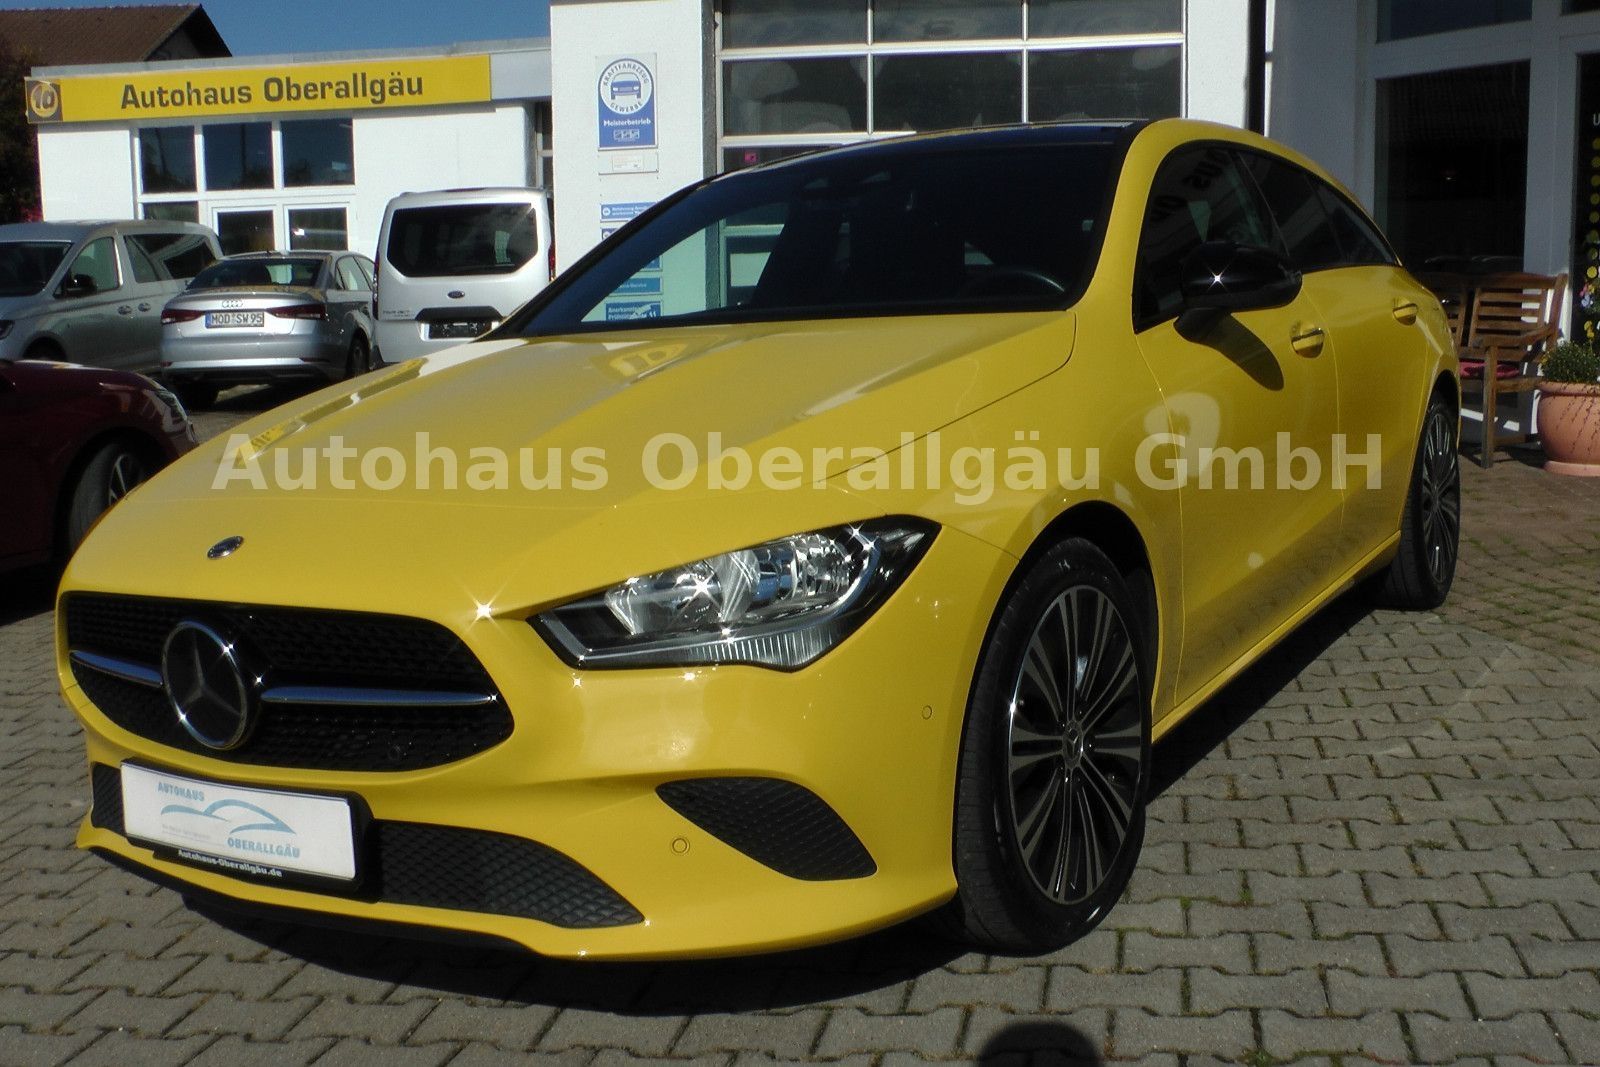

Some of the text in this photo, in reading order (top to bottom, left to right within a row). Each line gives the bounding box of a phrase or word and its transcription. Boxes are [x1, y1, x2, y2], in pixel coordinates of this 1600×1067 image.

[603, 62, 650, 86] KRAFTFAHRZEUG
[121, 72, 423, 110] Autohaus Oberallgäu
[610, 102, 643, 113] GEWERBE
[603, 117, 652, 127] Meisterbetrieb
[157, 782, 205, 802] AUTOHAUS
[227, 836, 301, 859] OBERALLGÄU
